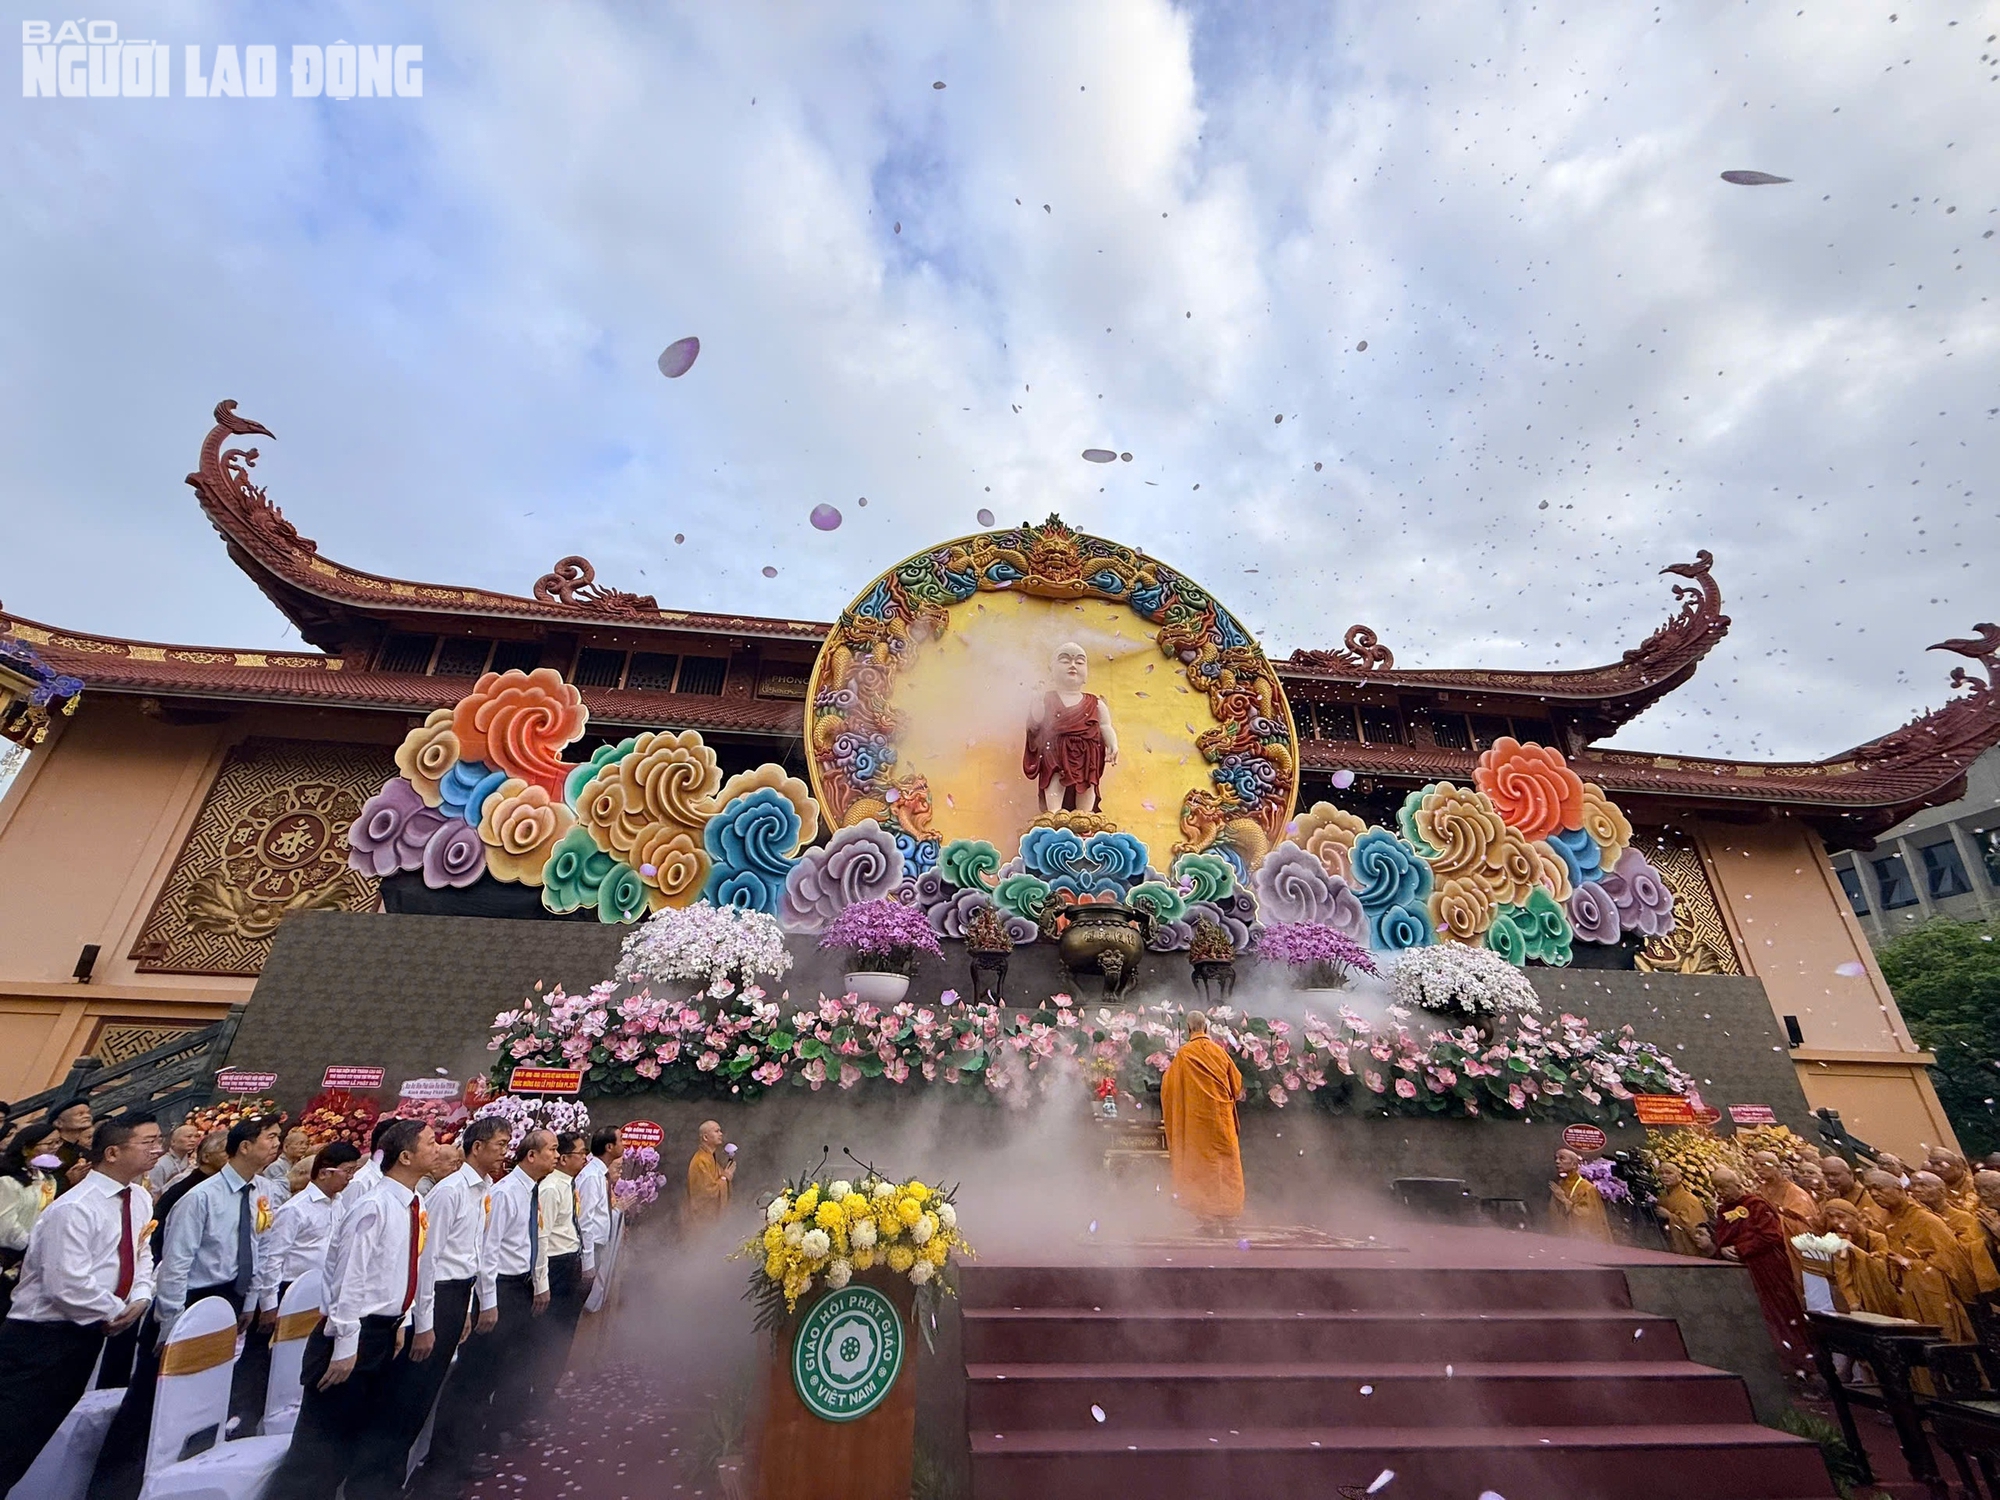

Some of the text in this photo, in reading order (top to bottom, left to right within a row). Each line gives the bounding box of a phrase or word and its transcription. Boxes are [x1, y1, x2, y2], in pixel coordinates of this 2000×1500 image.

[805, 1295, 896, 1371] GIÁO HỘI PHẬT GIÁO
[817, 1380, 877, 1407] VIỆT NAM
